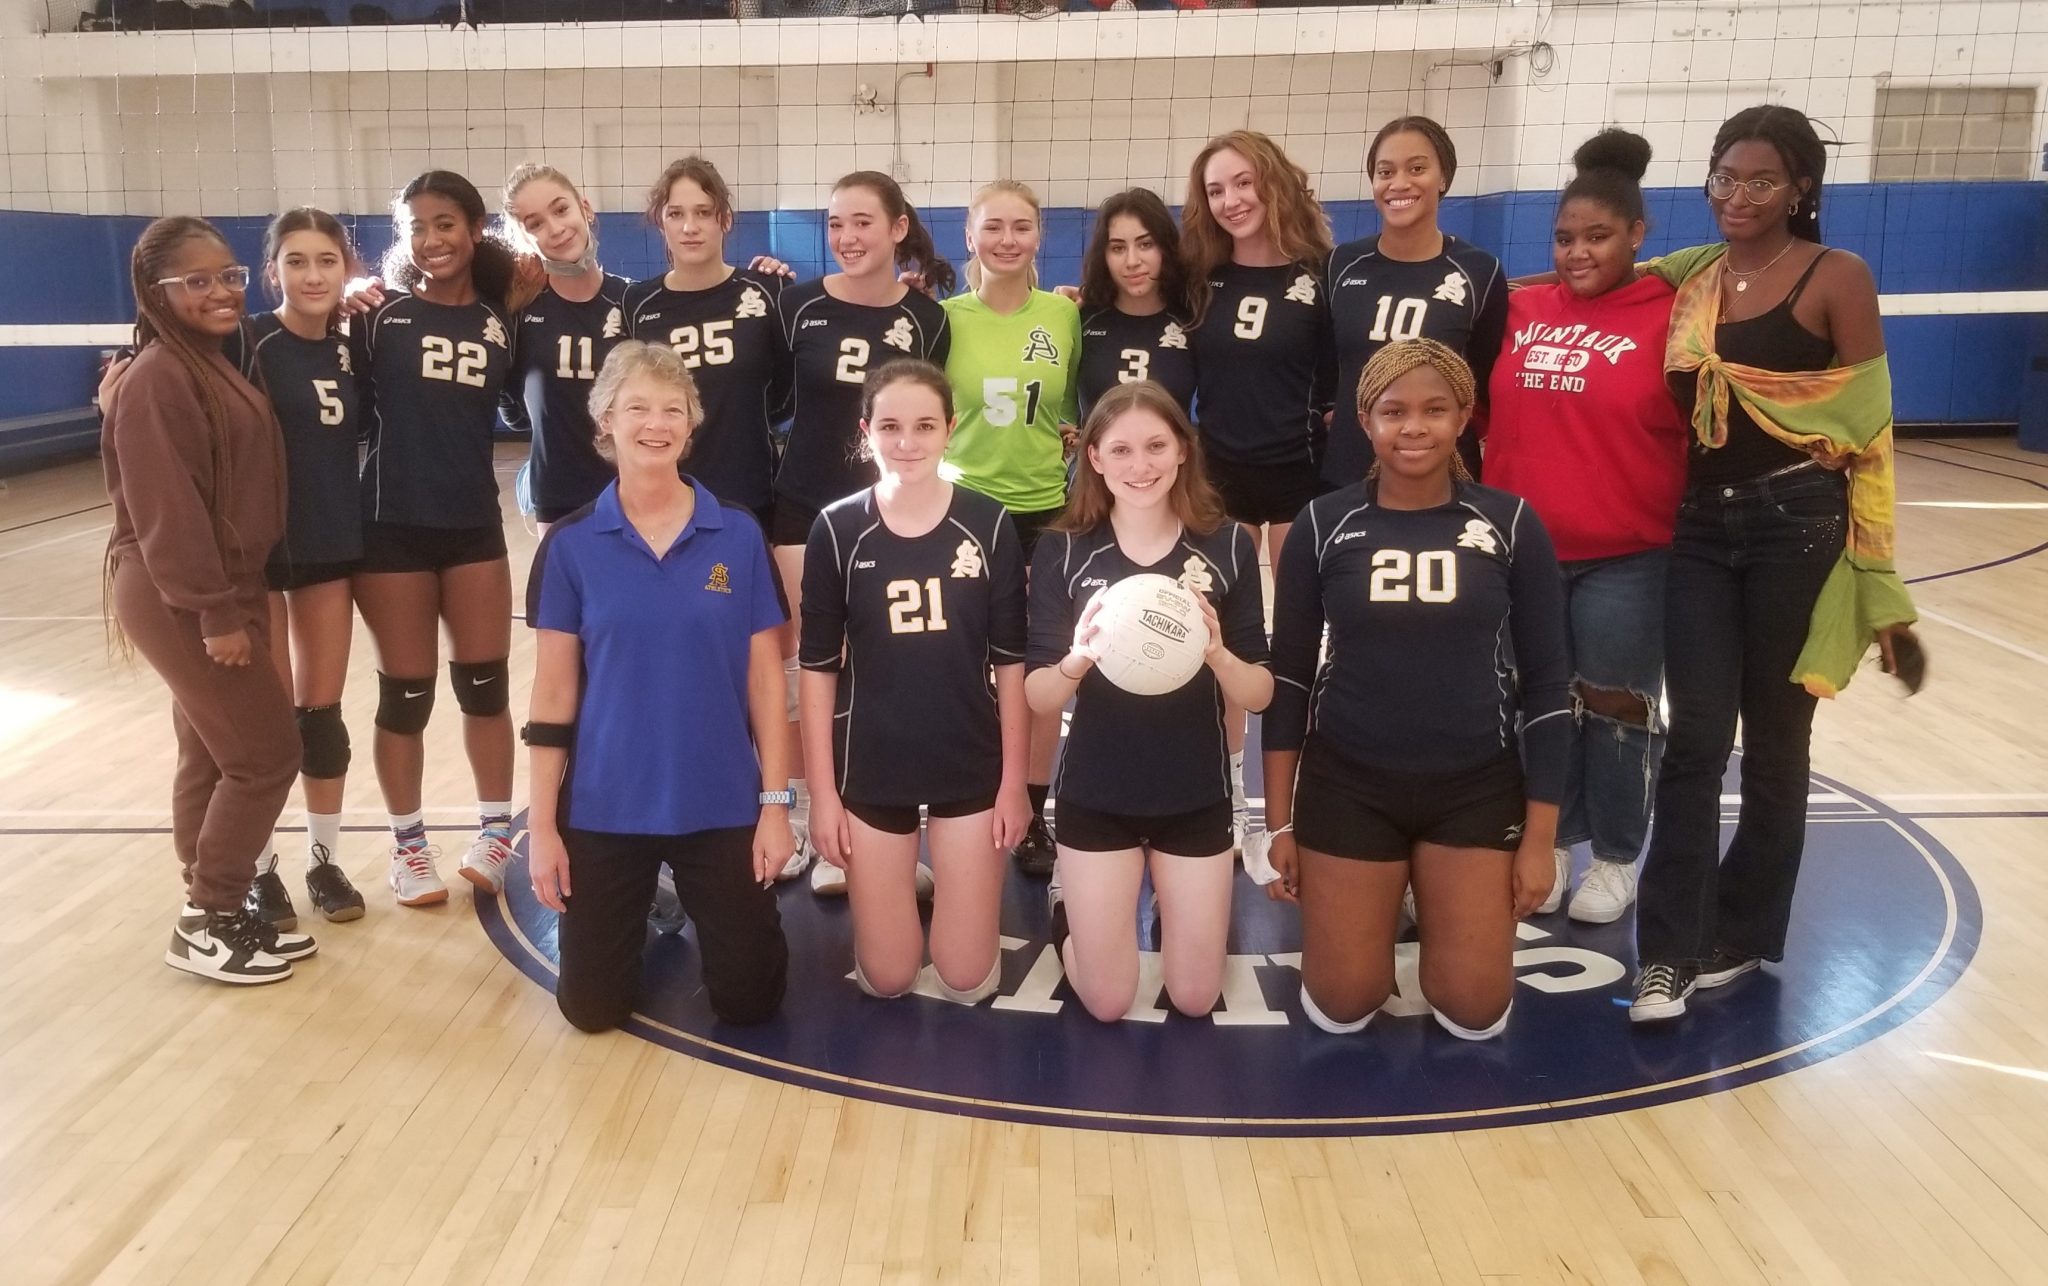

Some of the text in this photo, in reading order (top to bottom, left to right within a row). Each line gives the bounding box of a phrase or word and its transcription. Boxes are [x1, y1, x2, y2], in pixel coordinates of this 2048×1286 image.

[1234, 296, 1268, 340] 9
[1368, 295, 1428, 342] 10
[421, 335, 488, 388] 22
[556, 335, 595, 379] 11
[670, 320, 734, 369] 25
[836, 337, 870, 384] 2
[1118, 348, 1150, 384] 3
[1527, 350, 1549, 364] EST.
[312, 380, 344, 425] 5
[983, 378, 1041, 427] 51
[1515, 372, 1586, 393] HE END
[1344, 531, 1366, 540] asics
[1370, 549, 1456, 603] 20
[886, 577, 948, 634] 21
[1142, 609, 1186, 640] TACHIKARA
